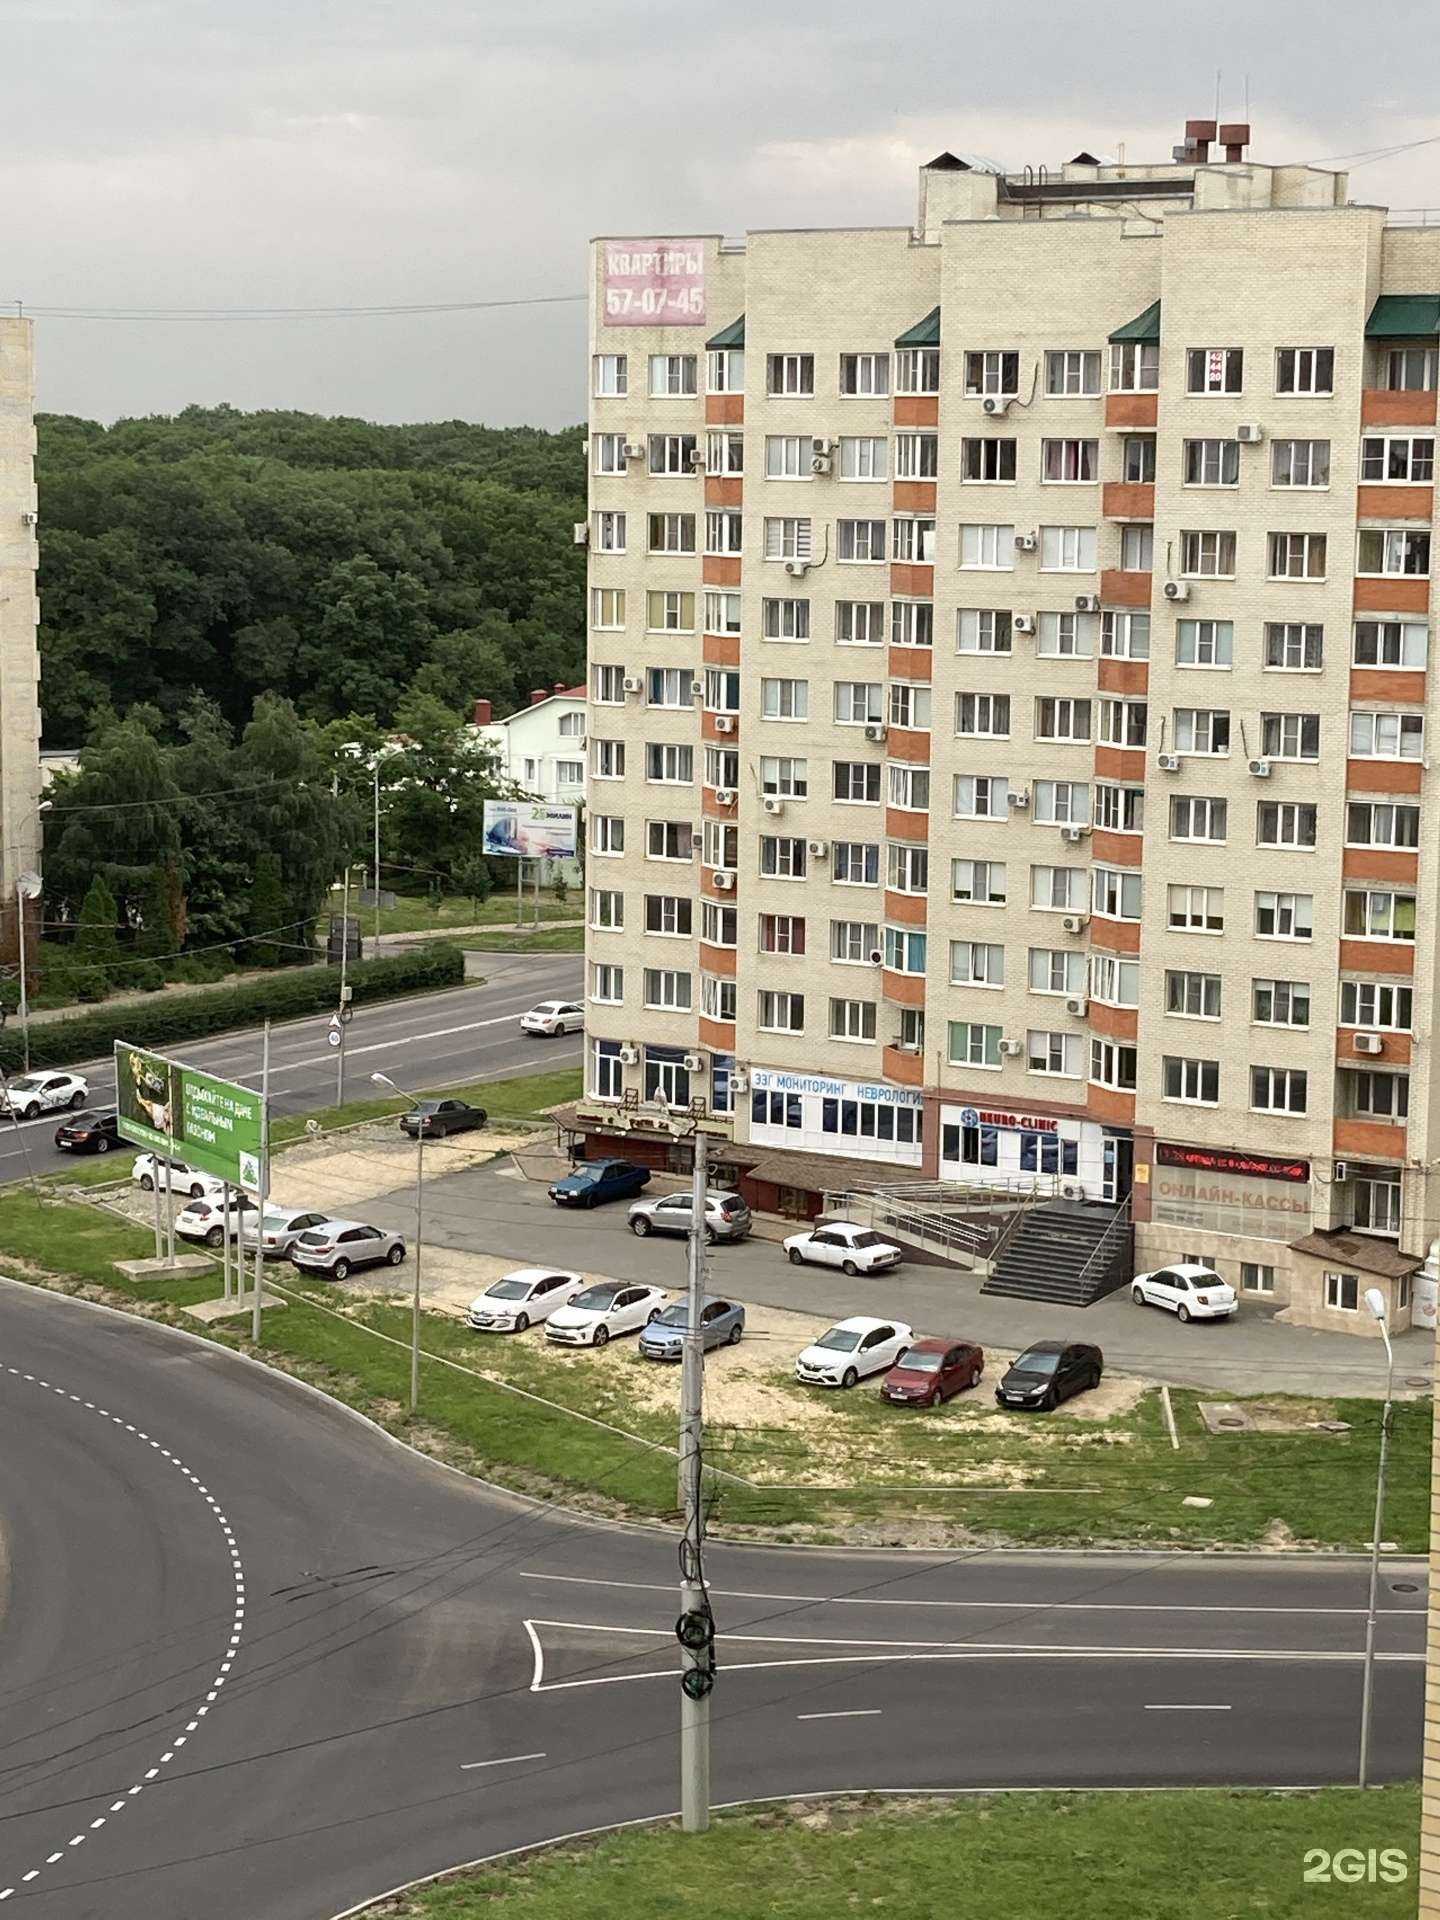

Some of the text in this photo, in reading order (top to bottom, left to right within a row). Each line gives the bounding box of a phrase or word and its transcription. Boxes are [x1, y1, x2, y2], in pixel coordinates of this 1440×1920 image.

[607, 251, 703, 276] КВАРТИРЫ
[606, 287, 704, 315] 57-07-45
[777, 1076, 847, 1097] МОНИТОРИНГ
[857, 1084, 925, 1106] НЕВРОЛОГИ
[1159, 1181, 1309, 1213] ОНЛАЙН-КАССЫ
